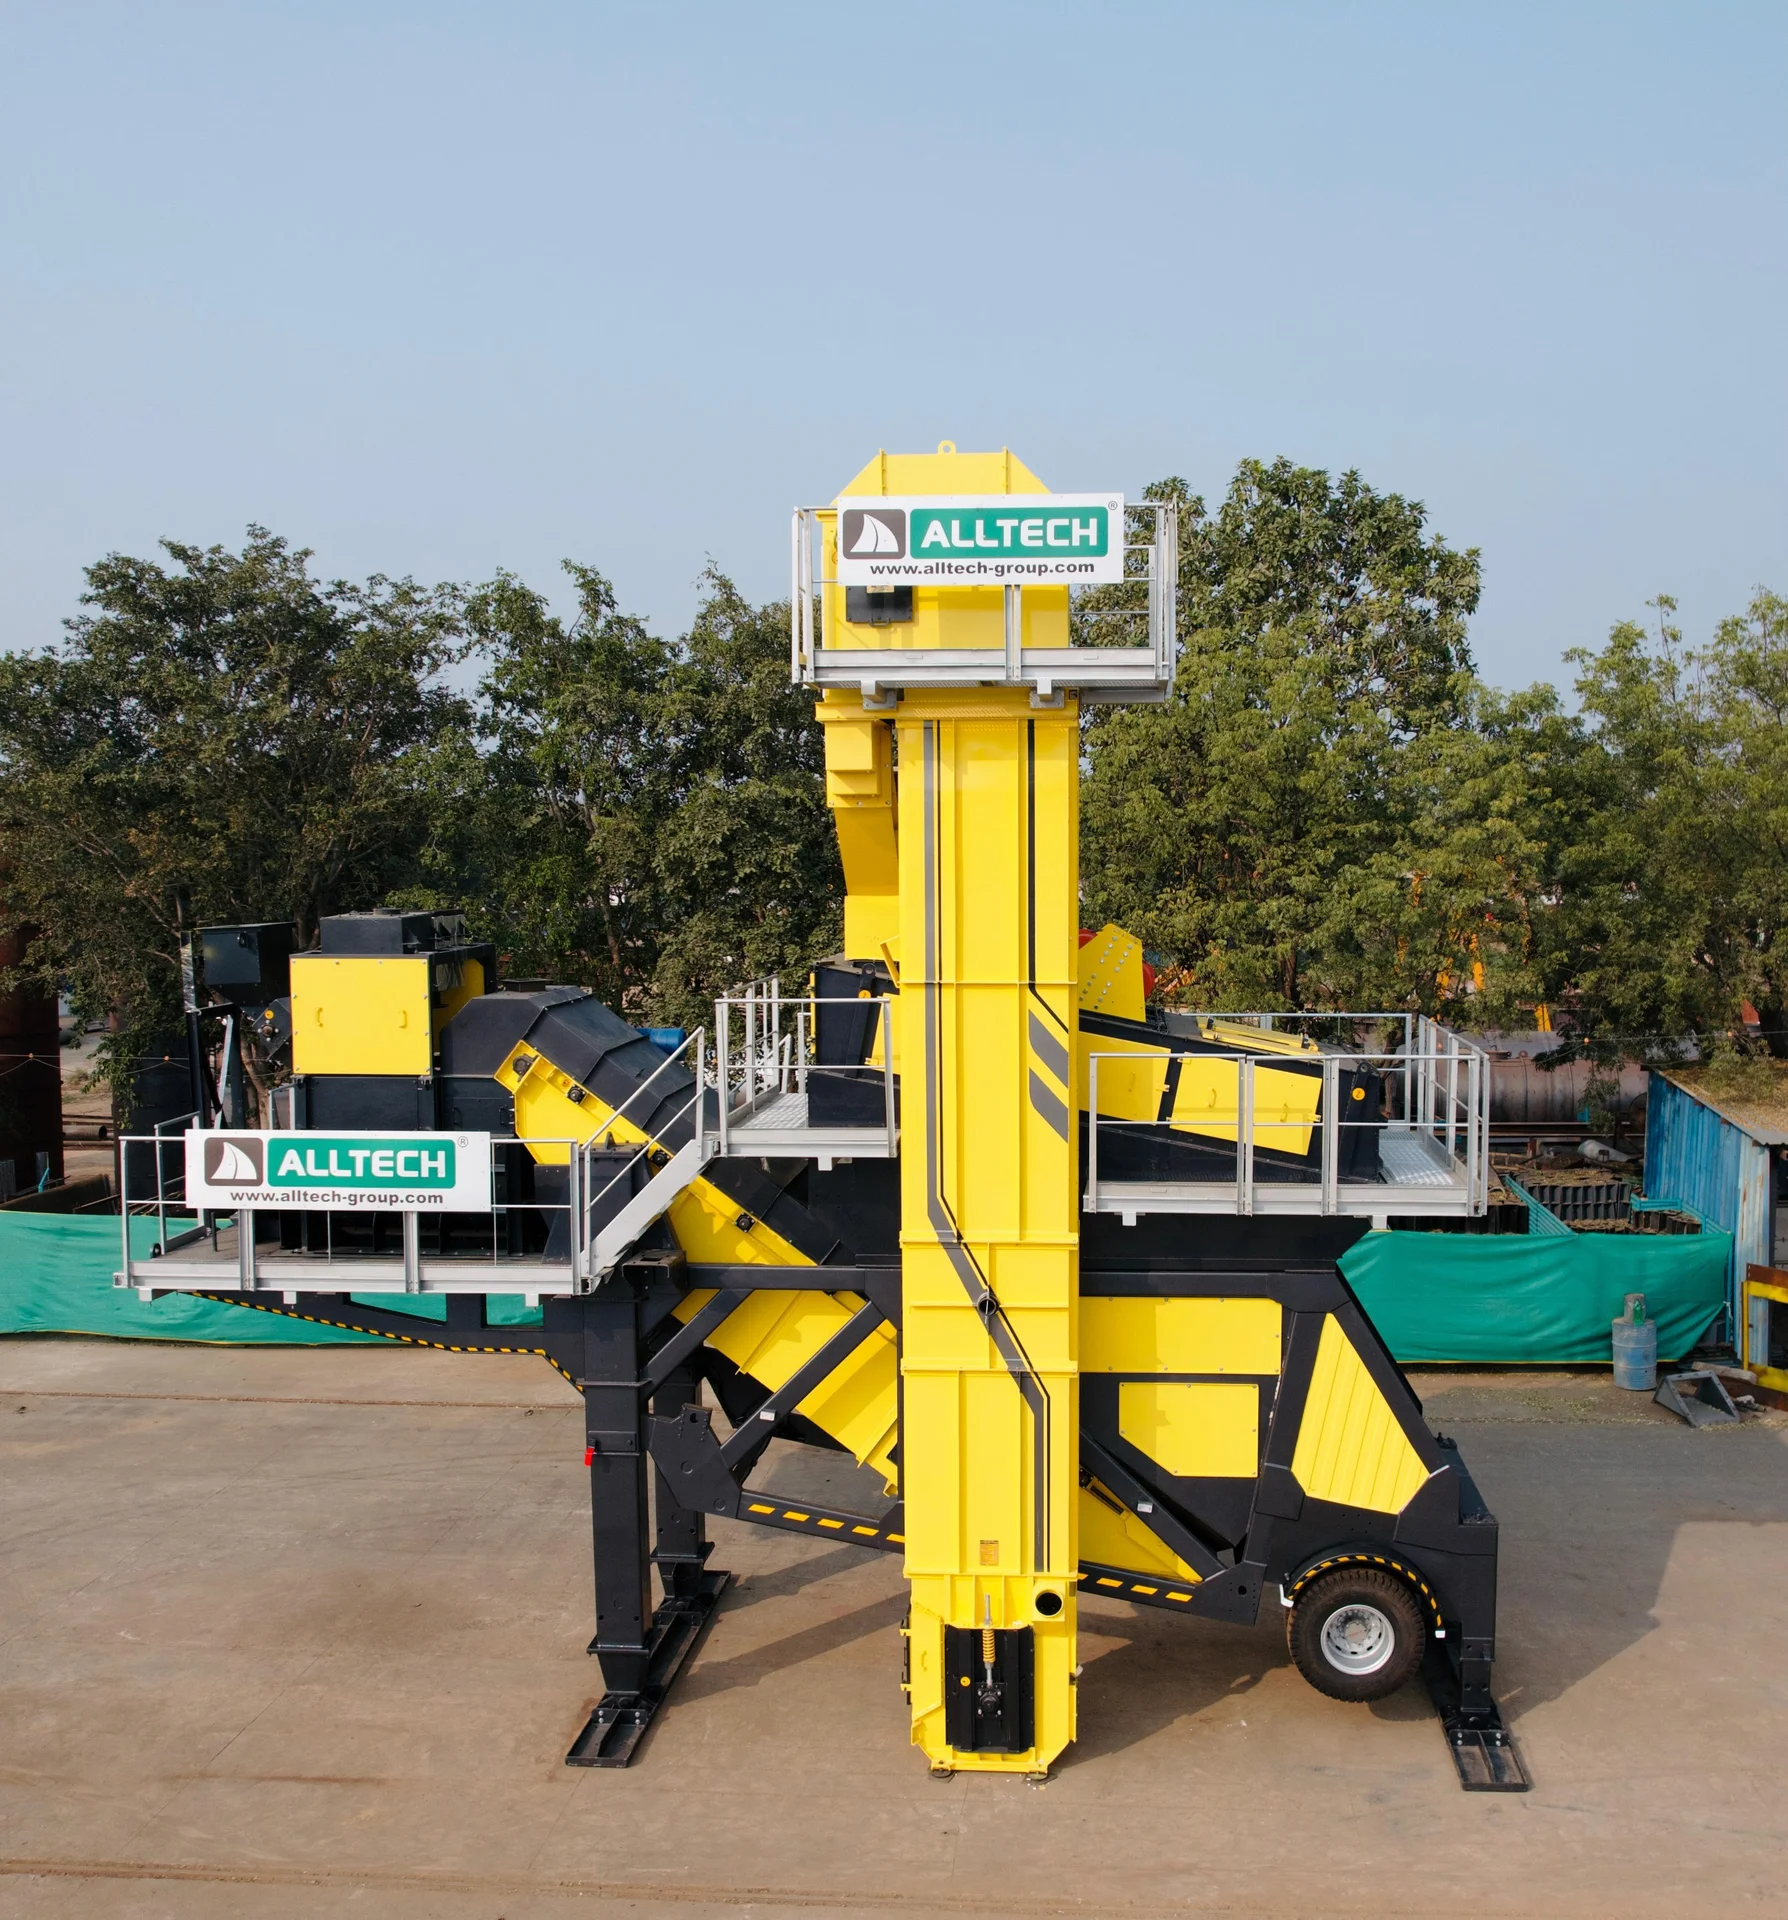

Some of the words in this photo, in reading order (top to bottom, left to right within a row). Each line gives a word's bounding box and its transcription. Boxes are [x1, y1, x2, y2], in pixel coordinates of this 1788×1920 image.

[920, 517, 1098, 548] ALLTECH
[870, 561, 1095, 578] www.alltech-group.com
[277, 1148, 446, 1178] ALLTECH
[230, 1190, 444, 1206] www.alltech-group.com
